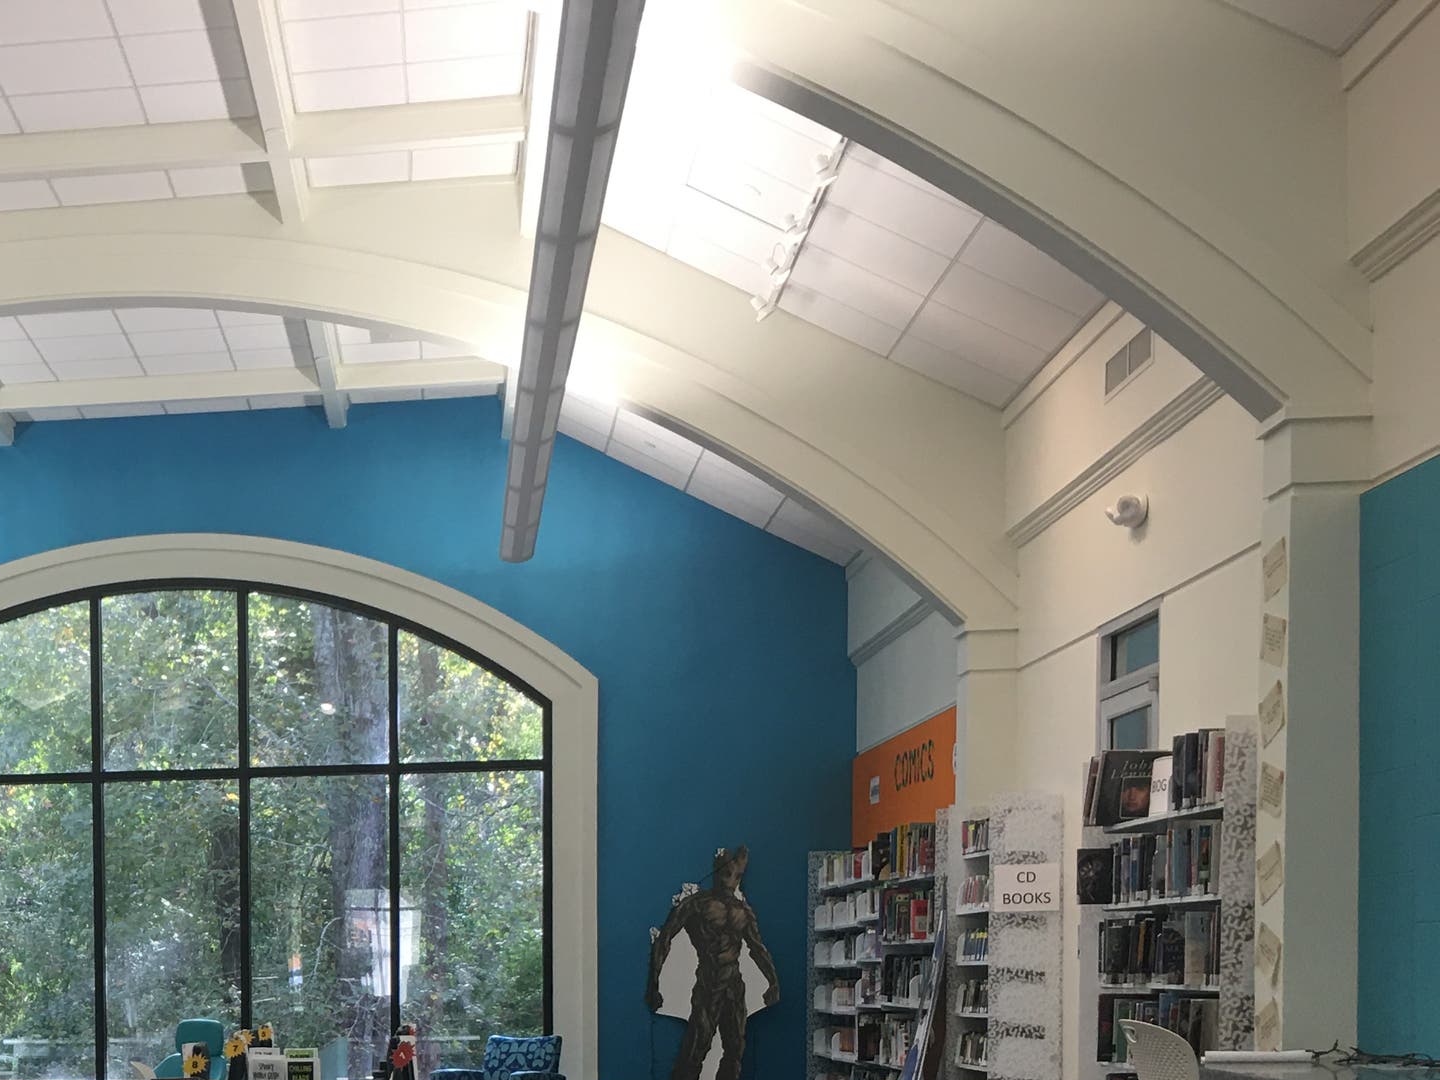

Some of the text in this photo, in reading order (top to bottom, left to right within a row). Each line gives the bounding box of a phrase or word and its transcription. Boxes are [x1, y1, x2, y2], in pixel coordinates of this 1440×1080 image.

[894, 739, 935, 792] COMICS
[1017, 871, 1036, 883] CD
[1003, 892, 1051, 905] BOOKS
